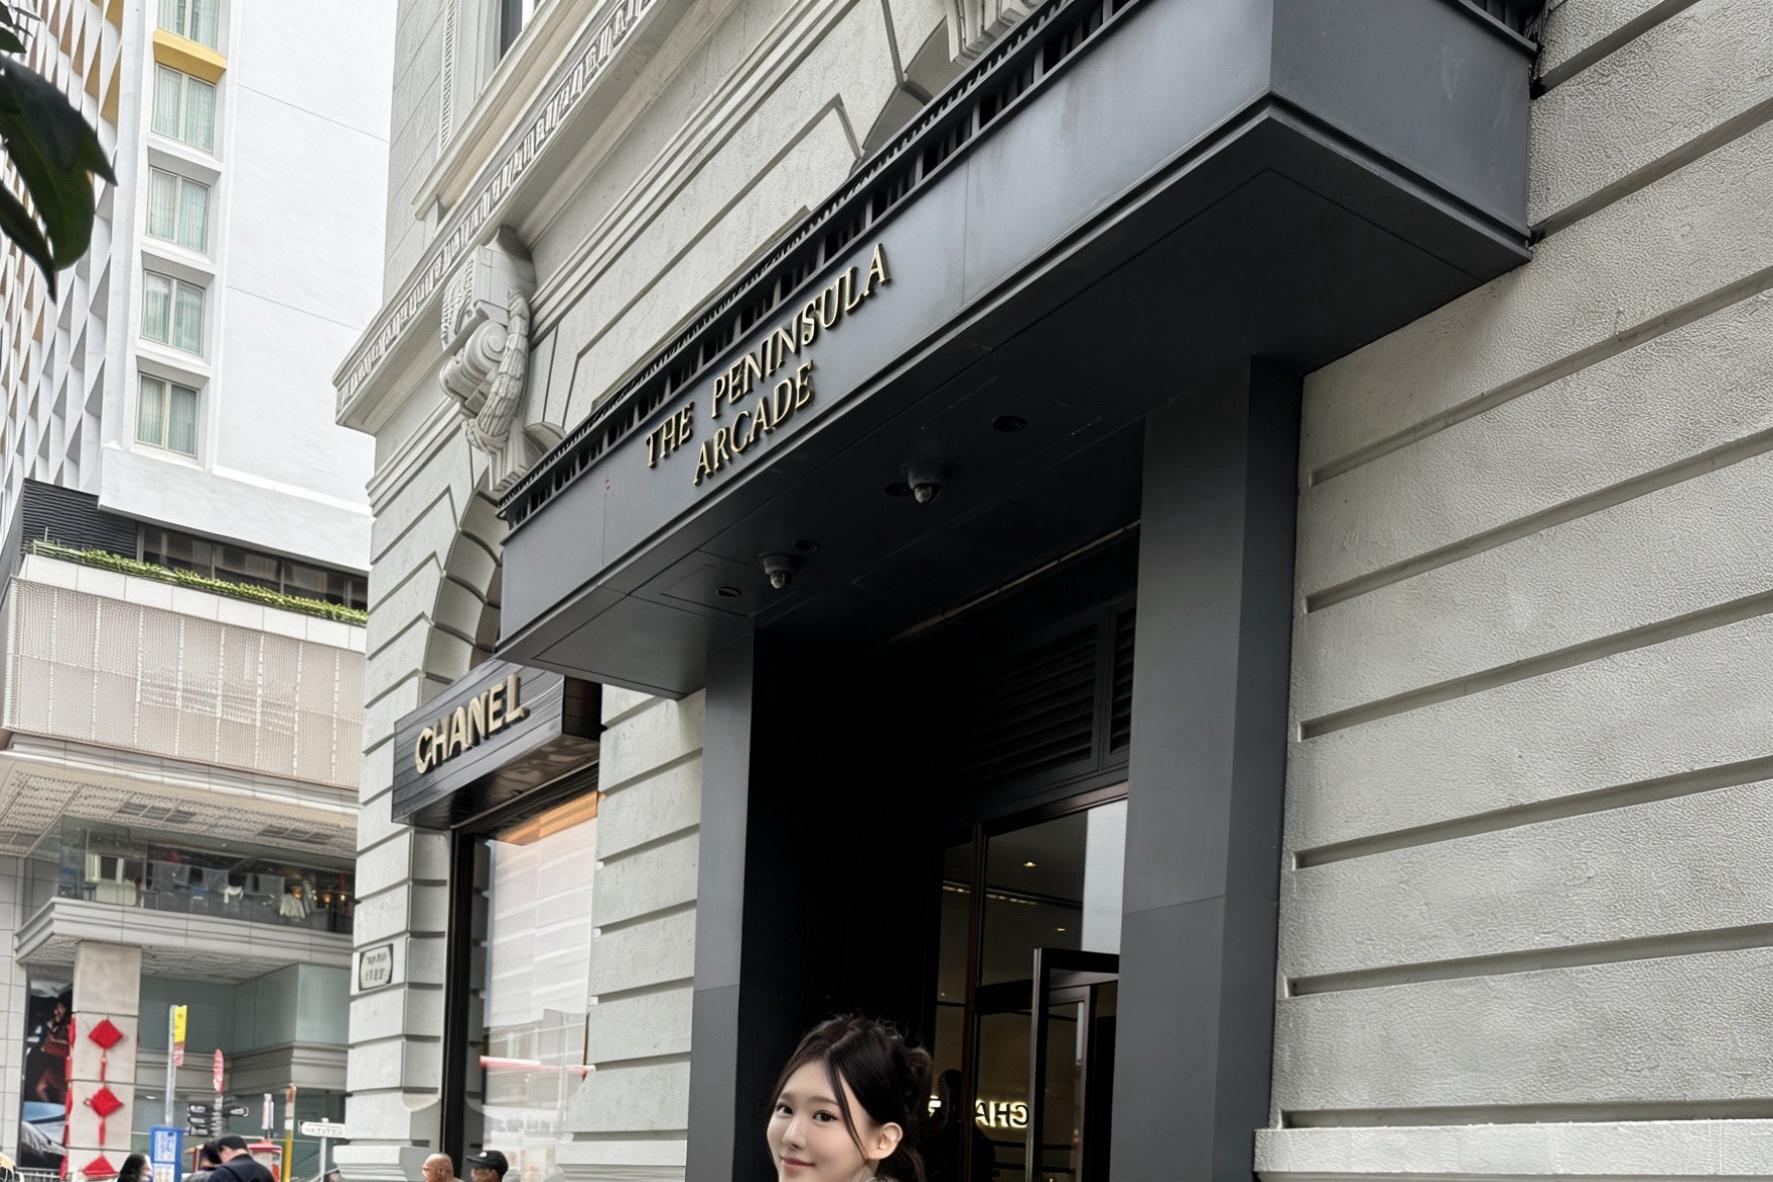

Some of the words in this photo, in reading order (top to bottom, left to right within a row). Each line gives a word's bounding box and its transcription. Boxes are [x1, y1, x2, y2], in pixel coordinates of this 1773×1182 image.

[647, 402, 694, 467] THE
[711, 243, 891, 419] PENINSULA
[693, 360, 816, 485] ARCADE
[415, 672, 528, 774] CHANEL
